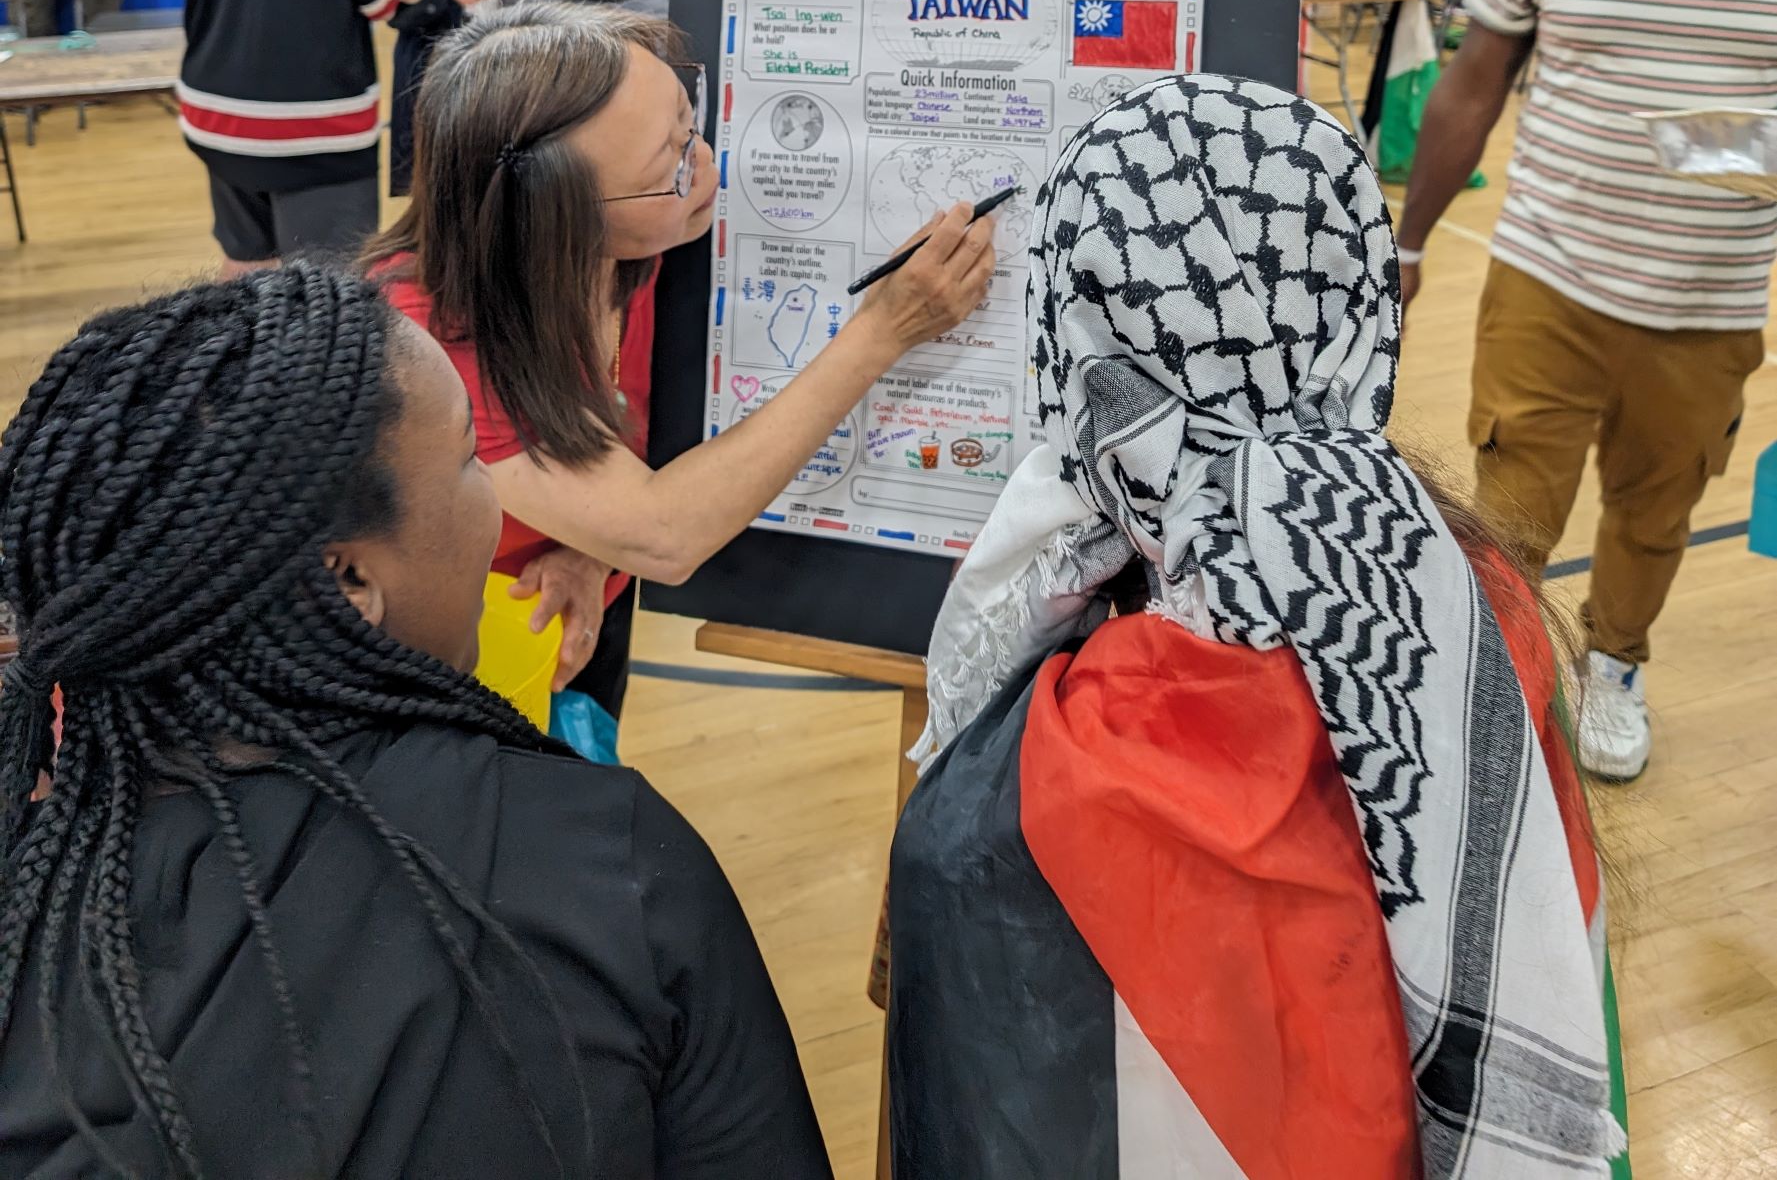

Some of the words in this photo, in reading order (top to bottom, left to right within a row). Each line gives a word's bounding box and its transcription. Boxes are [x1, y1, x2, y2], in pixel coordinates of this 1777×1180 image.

[762, 6, 787, 20] Tsai
[754, 22, 771, 32] What
[772, 23, 799, 34] position
[801, 24, 817, 34] does
[819, 23, 827, 34] he
[830, 26, 837, 34] or
[910, 26, 952, 41] Republic
[955, 27, 969, 39] of
[971, 27, 1001, 40] China
[752, 34, 763, 44] she
[766, 34, 785, 45] hold?
[901, 68, 935, 87] Quick
[941, 70, 1016, 91] Information
[1006, 93, 1028, 104] Asia
[909, 111, 940, 123] Taipei
[751, 148, 757, 159] If
[759, 152, 771, 161] you
[773, 152, 789, 161] were
[792, 152, 799, 161] to
[800, 152, 820, 163] travel
[822, 152, 840, 164] from
[752, 164, 766, 173] your
[769, 164, 781, 174] city
[783, 165, 791, 173] to
[793, 164, 803, 174] the
[805, 165, 837, 177] country's
[780, 176, 793, 186] how
[796, 179, 815, 190] many
[817, 178, 835, 188] miles
[993, 174, 1016, 188] ASIA
[763, 187, 784, 197] would
[786, 191, 798, 200] you
[800, 190, 824, 200] travel?
[761, 241, 779, 252] Draw
[781, 242, 793, 253] and
[796, 243, 812, 255] color
[815, 244, 825, 256] the
[765, 256, 796, 267] country's
[759, 266, 779, 276] Label
[780, 267, 788, 277] its
[790, 269, 813, 280] capital
[897, 377, 910, 387] and
[931, 382, 944, 390] one
[946, 382, 954, 391] of
[955, 383, 966, 393] the
[968, 385, 1001, 398] country's
[886, 389, 912, 399] natural
[913, 392, 946, 404] resources
